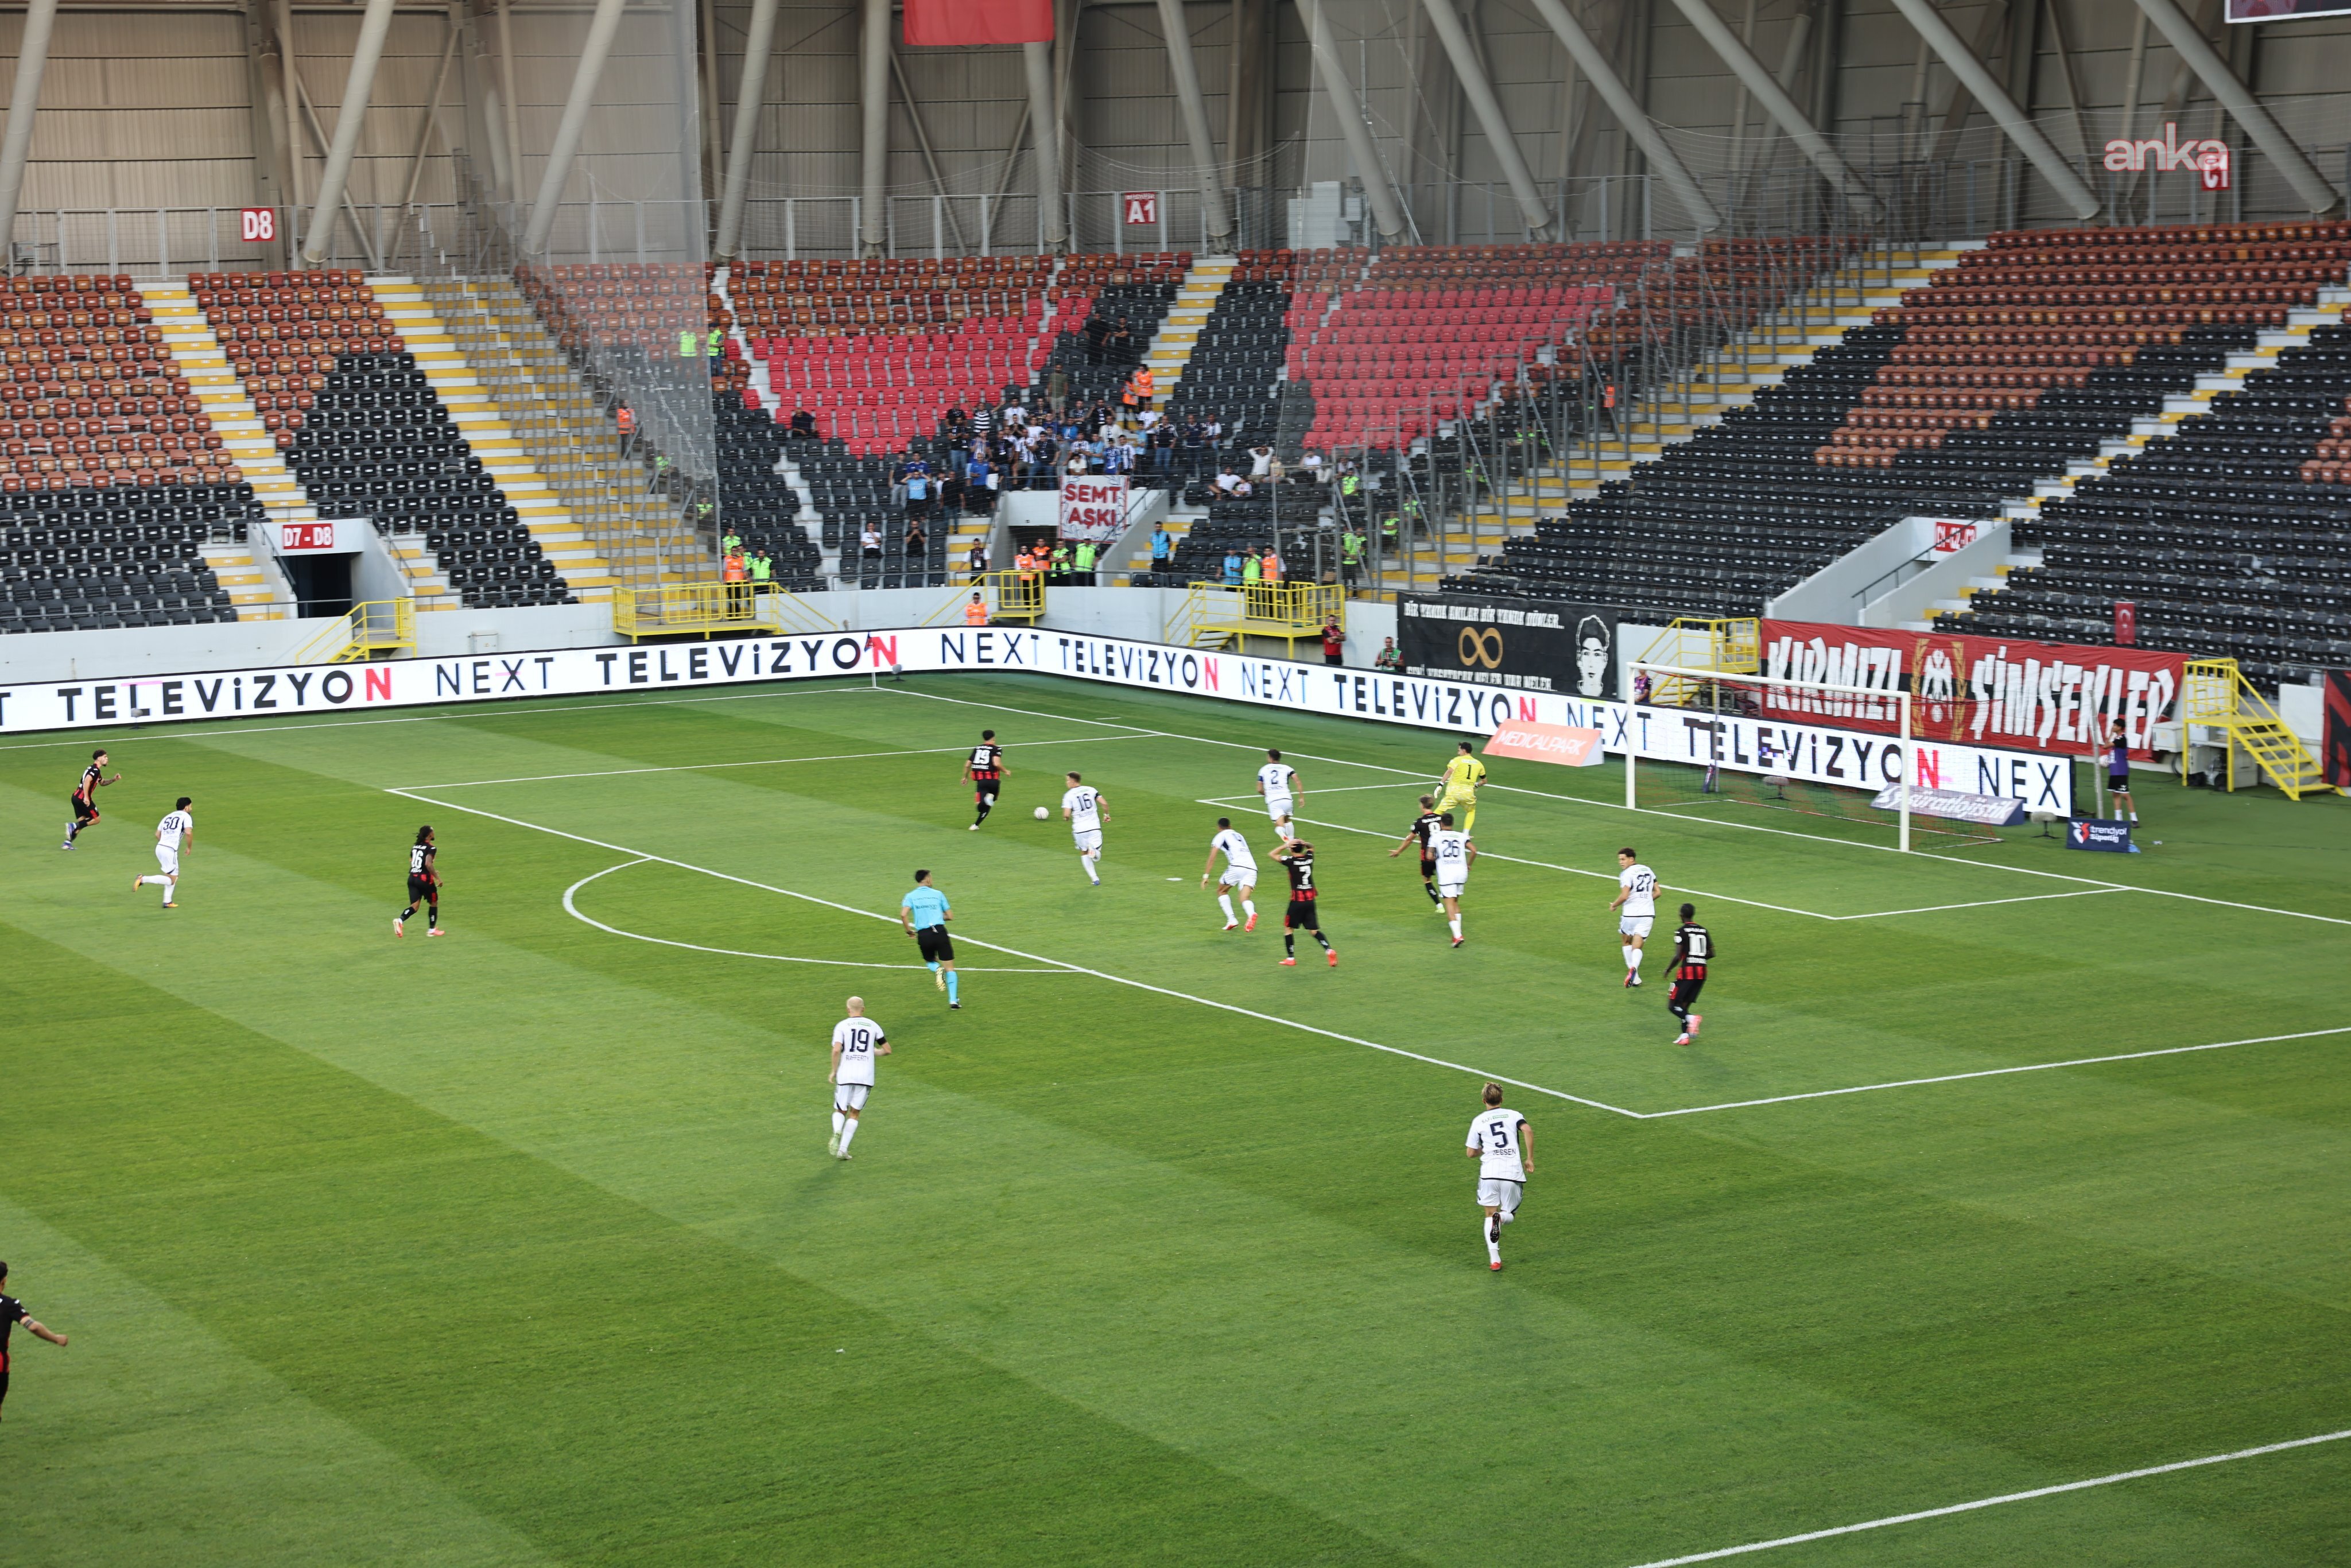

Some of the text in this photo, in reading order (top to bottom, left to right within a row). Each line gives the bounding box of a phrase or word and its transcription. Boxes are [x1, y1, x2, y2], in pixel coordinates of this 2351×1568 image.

[1127, 200, 1155, 223] A1
[243, 211, 273, 239] D8
[1065, 483, 1121, 503] SEMT
[1068, 507, 1116, 529] AŞKI
[284, 527, 302, 546] D7
[312, 526, 332, 545] D8
[1767, 636, 1902, 721] KIRMIZI
[436, 657, 554, 697] NEXT
[942, 632, 1039, 665] NEXT
[1242, 661, 1310, 704] NEXT
[1568, 702, 1651, 751] NEXT
[1979, 754, 2059, 809] NEX
[1271, 770, 1279, 785] 2
[1466, 764, 1472, 780] 1
[1077, 793, 1093, 812] 16
[163, 816, 180, 830] 50
[2090, 825, 2127, 836] trendyol
[412, 849, 424, 869] 16
[1442, 840, 1460, 858] 26
[1299, 865, 1312, 884] 7
[1636, 874, 1652, 892] 27
[1688, 934, 1707, 957] 10
[849, 1028, 870, 1053] 19
[1489, 1121, 1508, 1148] 5
